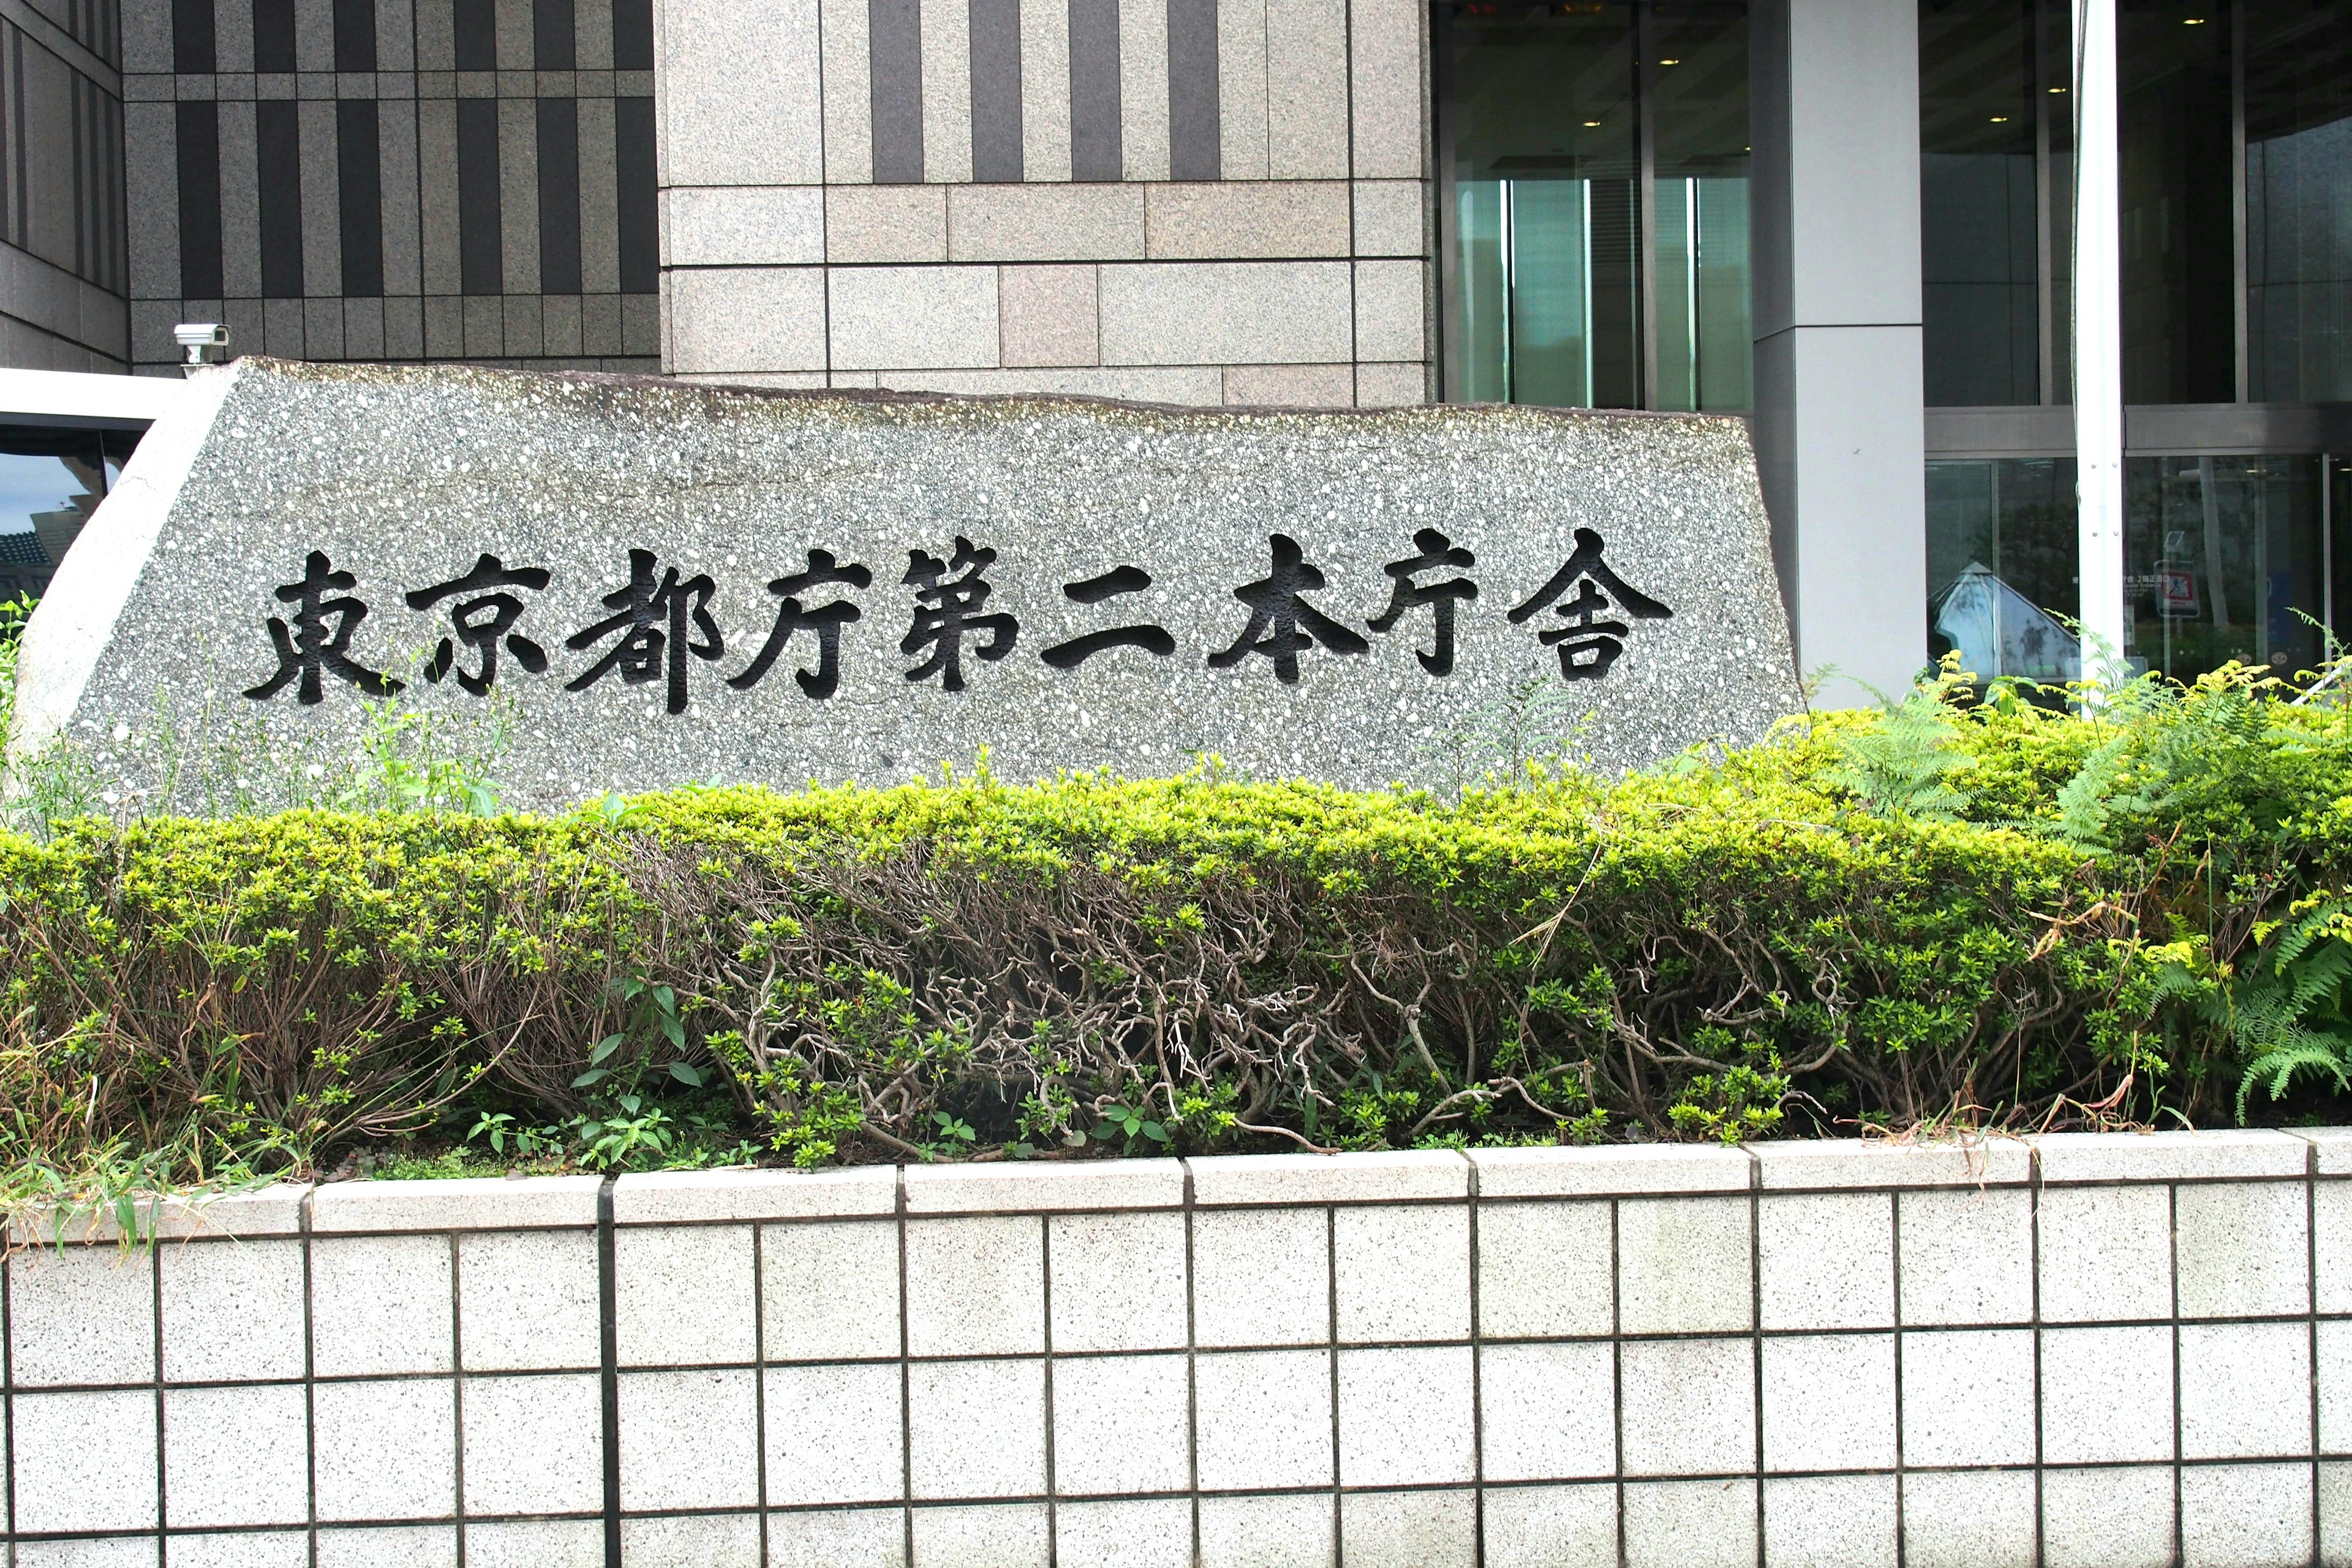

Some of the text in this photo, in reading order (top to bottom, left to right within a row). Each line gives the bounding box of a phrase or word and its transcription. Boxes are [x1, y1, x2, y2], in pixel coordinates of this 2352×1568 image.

[244, 528, 1673, 714] 東京都庁第二本庁舎
